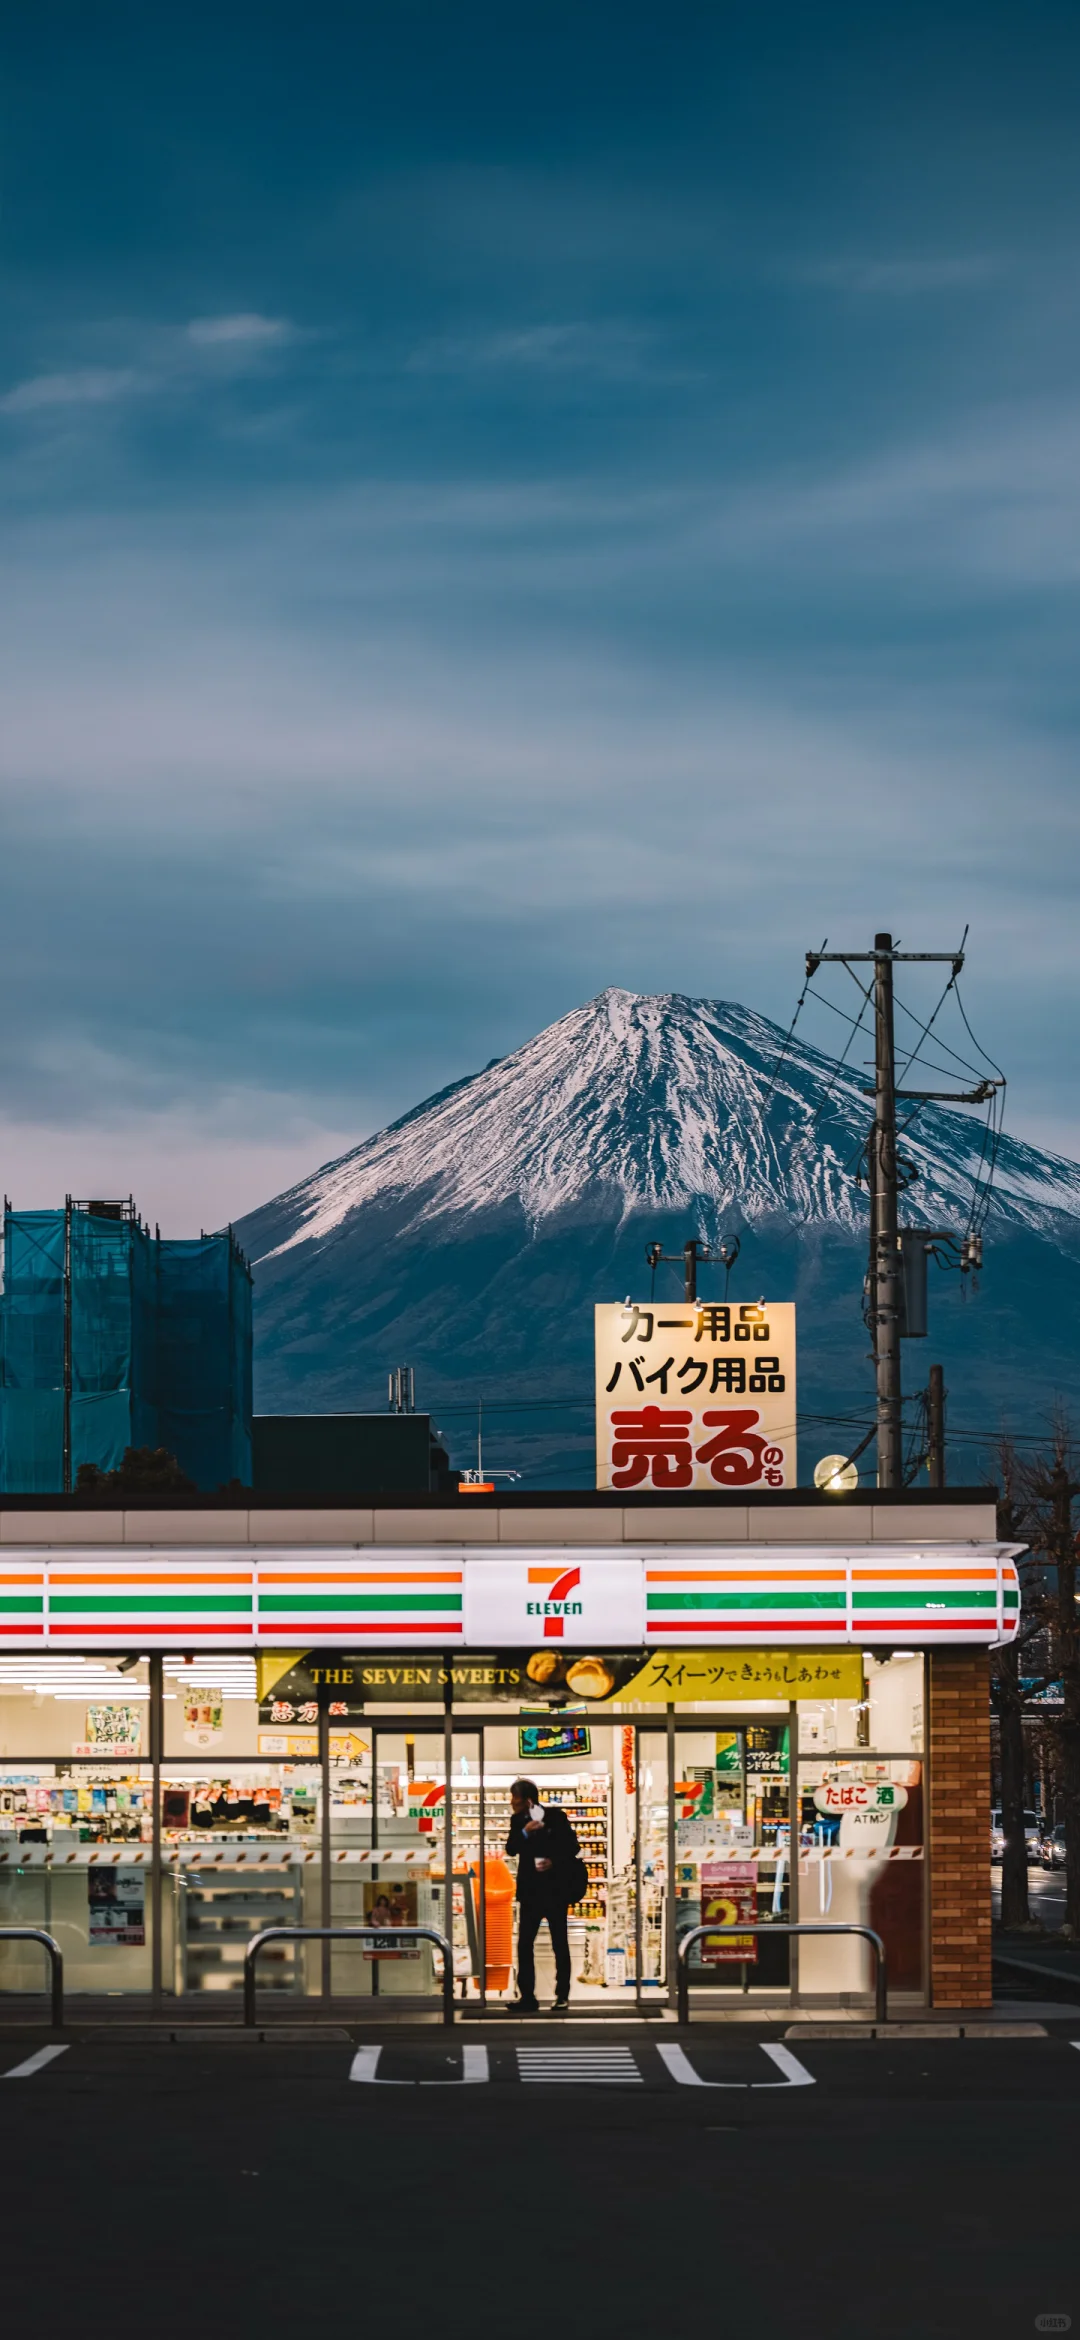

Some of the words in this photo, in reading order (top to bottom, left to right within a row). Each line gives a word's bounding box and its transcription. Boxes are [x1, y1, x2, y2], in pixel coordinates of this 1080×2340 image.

[621, 1306, 769, 1342] カー用品
[605, 1356, 786, 1394] バイク用品
[610, 1405, 769, 1488] 売る
[527, 1566, 581, 1637] 7
[310, 1668, 354, 1684] THE
[362, 1668, 432, 1684] SEVEN
[437, 1668, 520, 1684] SWEETS
[648, 1663, 842, 1687] スイーツできょうもしあわせ
[826, 1787, 868, 1805] たばこ
[876, 1786, 895, 1804] 酒
[853, 1814, 880, 1824] ATM
